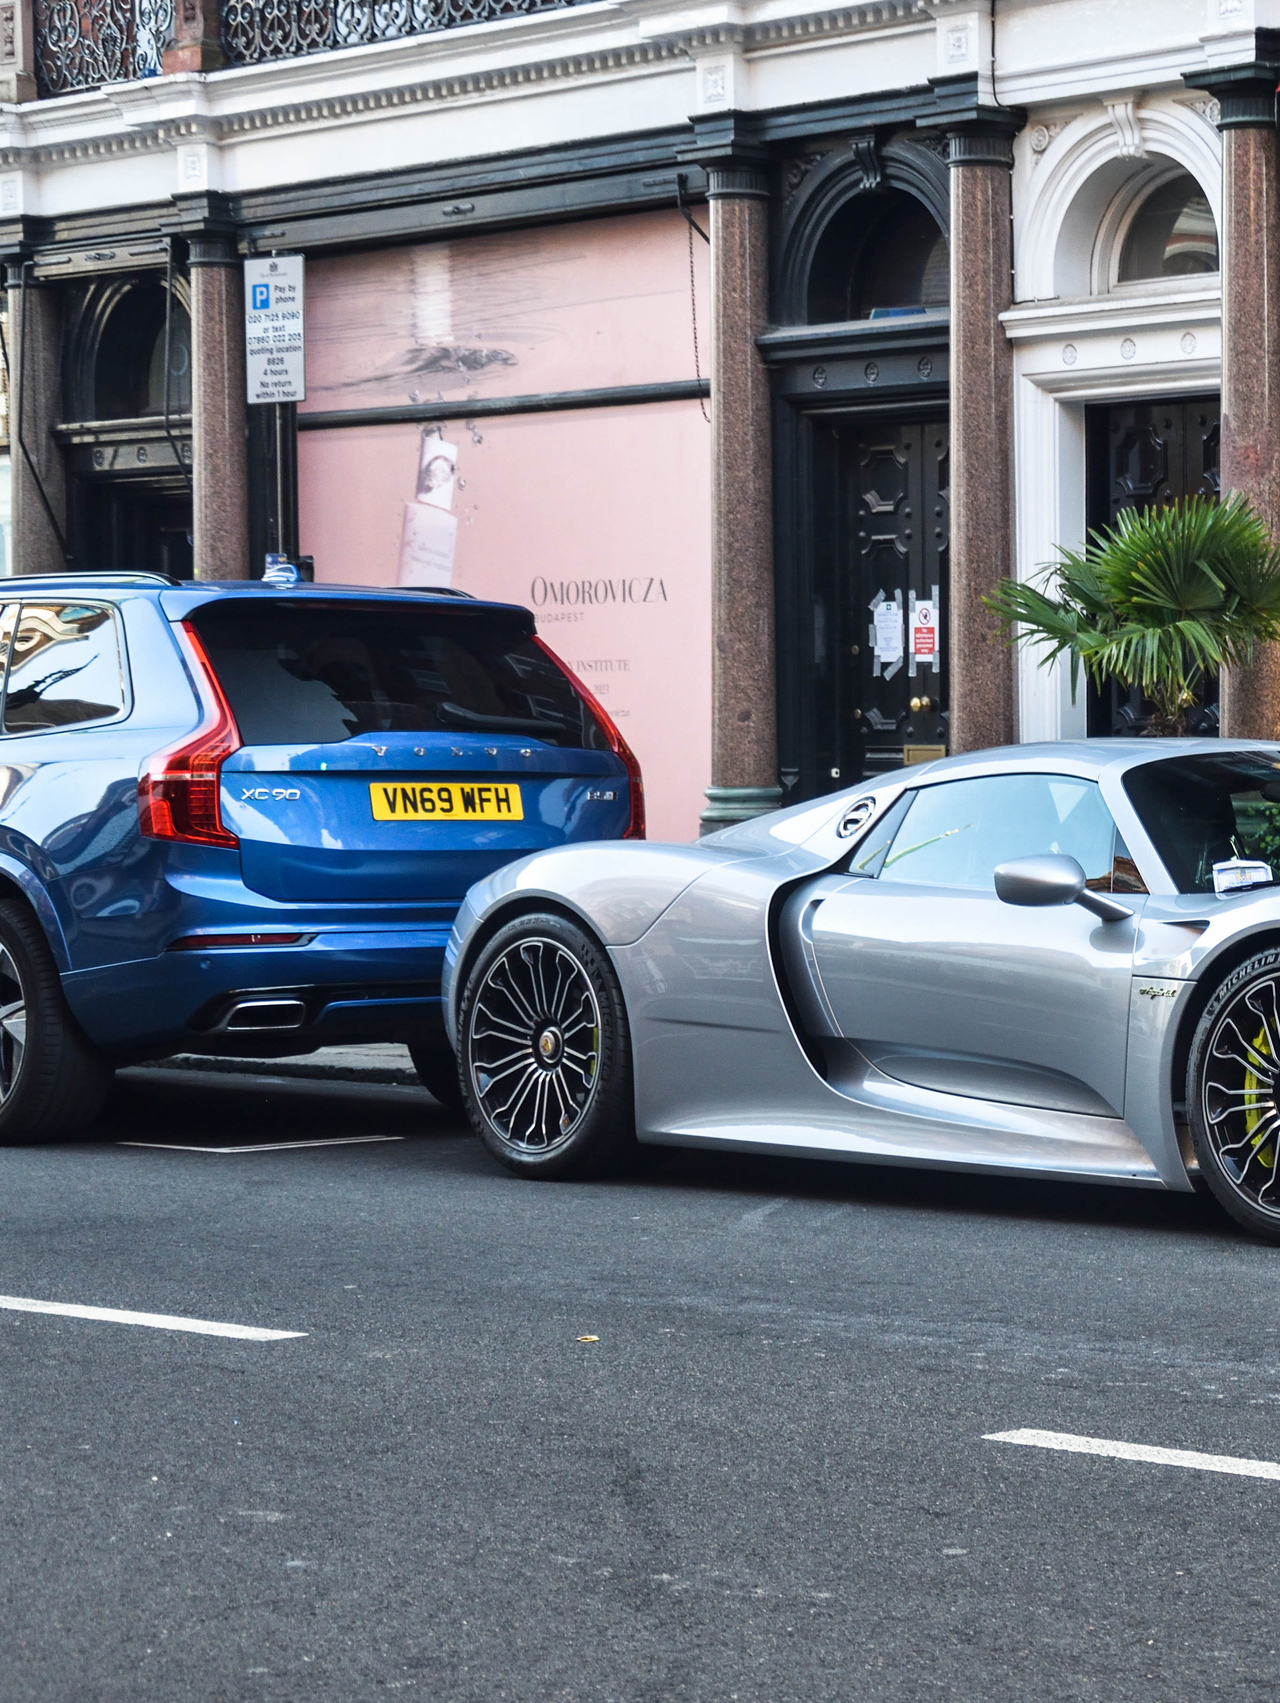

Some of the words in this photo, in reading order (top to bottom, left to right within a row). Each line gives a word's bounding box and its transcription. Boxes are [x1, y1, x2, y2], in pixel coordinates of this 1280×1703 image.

[274, 285, 286, 294] Pay
[287, 284, 296, 293] by
[275, 296, 296, 304] phone
[248, 314, 262, 324] 020
[272, 325, 286, 333] text
[249, 347, 274, 356] quoting
[275, 345, 302, 353] location
[263, 368, 269, 376] 4
[270, 368, 289, 376] hours
[260, 381, 269, 389] No
[271, 380, 292, 388] return
[256, 390, 275, 399] within
[534, 612, 584, 623] BUDAPEST
[577, 659, 630, 672] INSTITUTE
[383, 787, 454, 814] VN69
[460, 787, 512, 813] WFH
[1219, 953, 1277, 1001] MICHELIN
